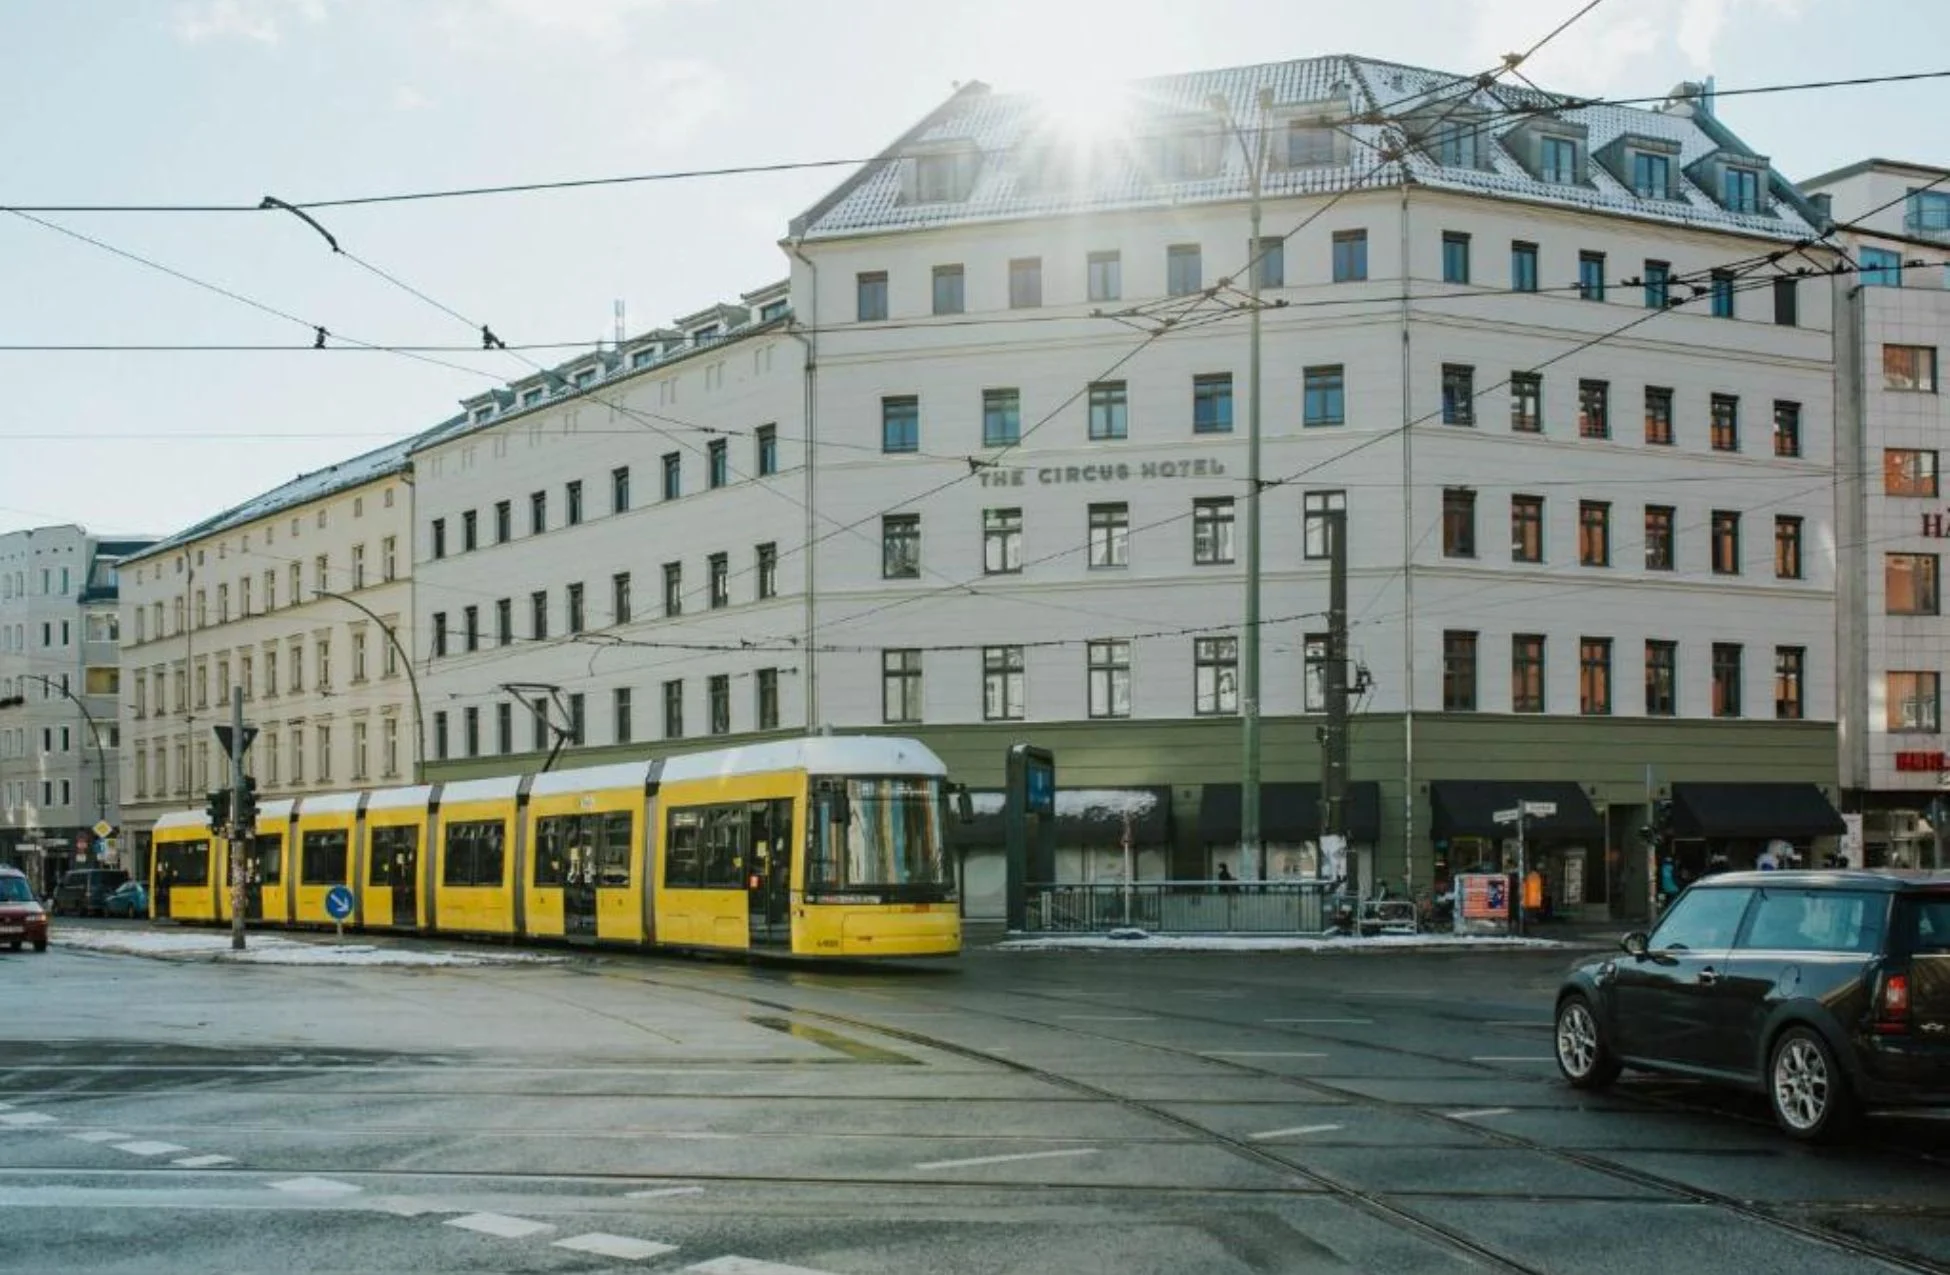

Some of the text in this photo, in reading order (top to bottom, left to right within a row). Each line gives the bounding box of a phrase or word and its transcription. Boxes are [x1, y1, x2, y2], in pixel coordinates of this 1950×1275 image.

[979, 457, 1225, 488] THE CIRCUS HOTEL
